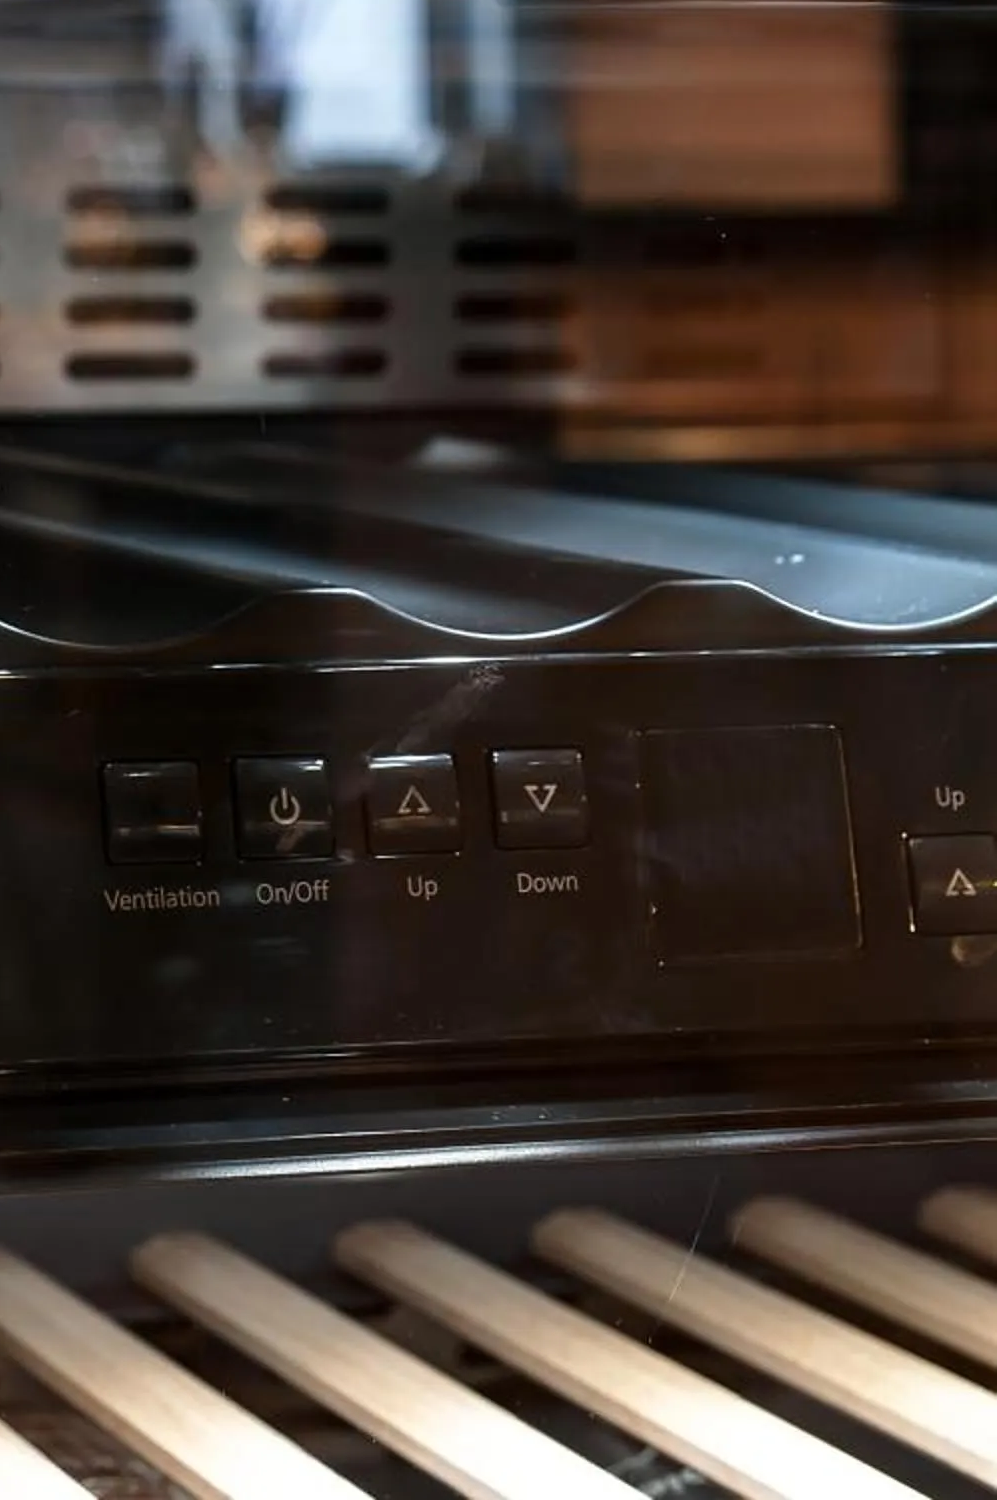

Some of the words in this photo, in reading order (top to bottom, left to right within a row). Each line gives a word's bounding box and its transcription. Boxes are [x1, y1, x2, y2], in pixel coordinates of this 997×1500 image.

[935, 786, 966, 811] Up
[256, 879, 331, 905] On/Off
[407, 874, 439, 901] Up
[516, 872, 579, 895] Down
[103, 886, 221, 911] Ventilation
